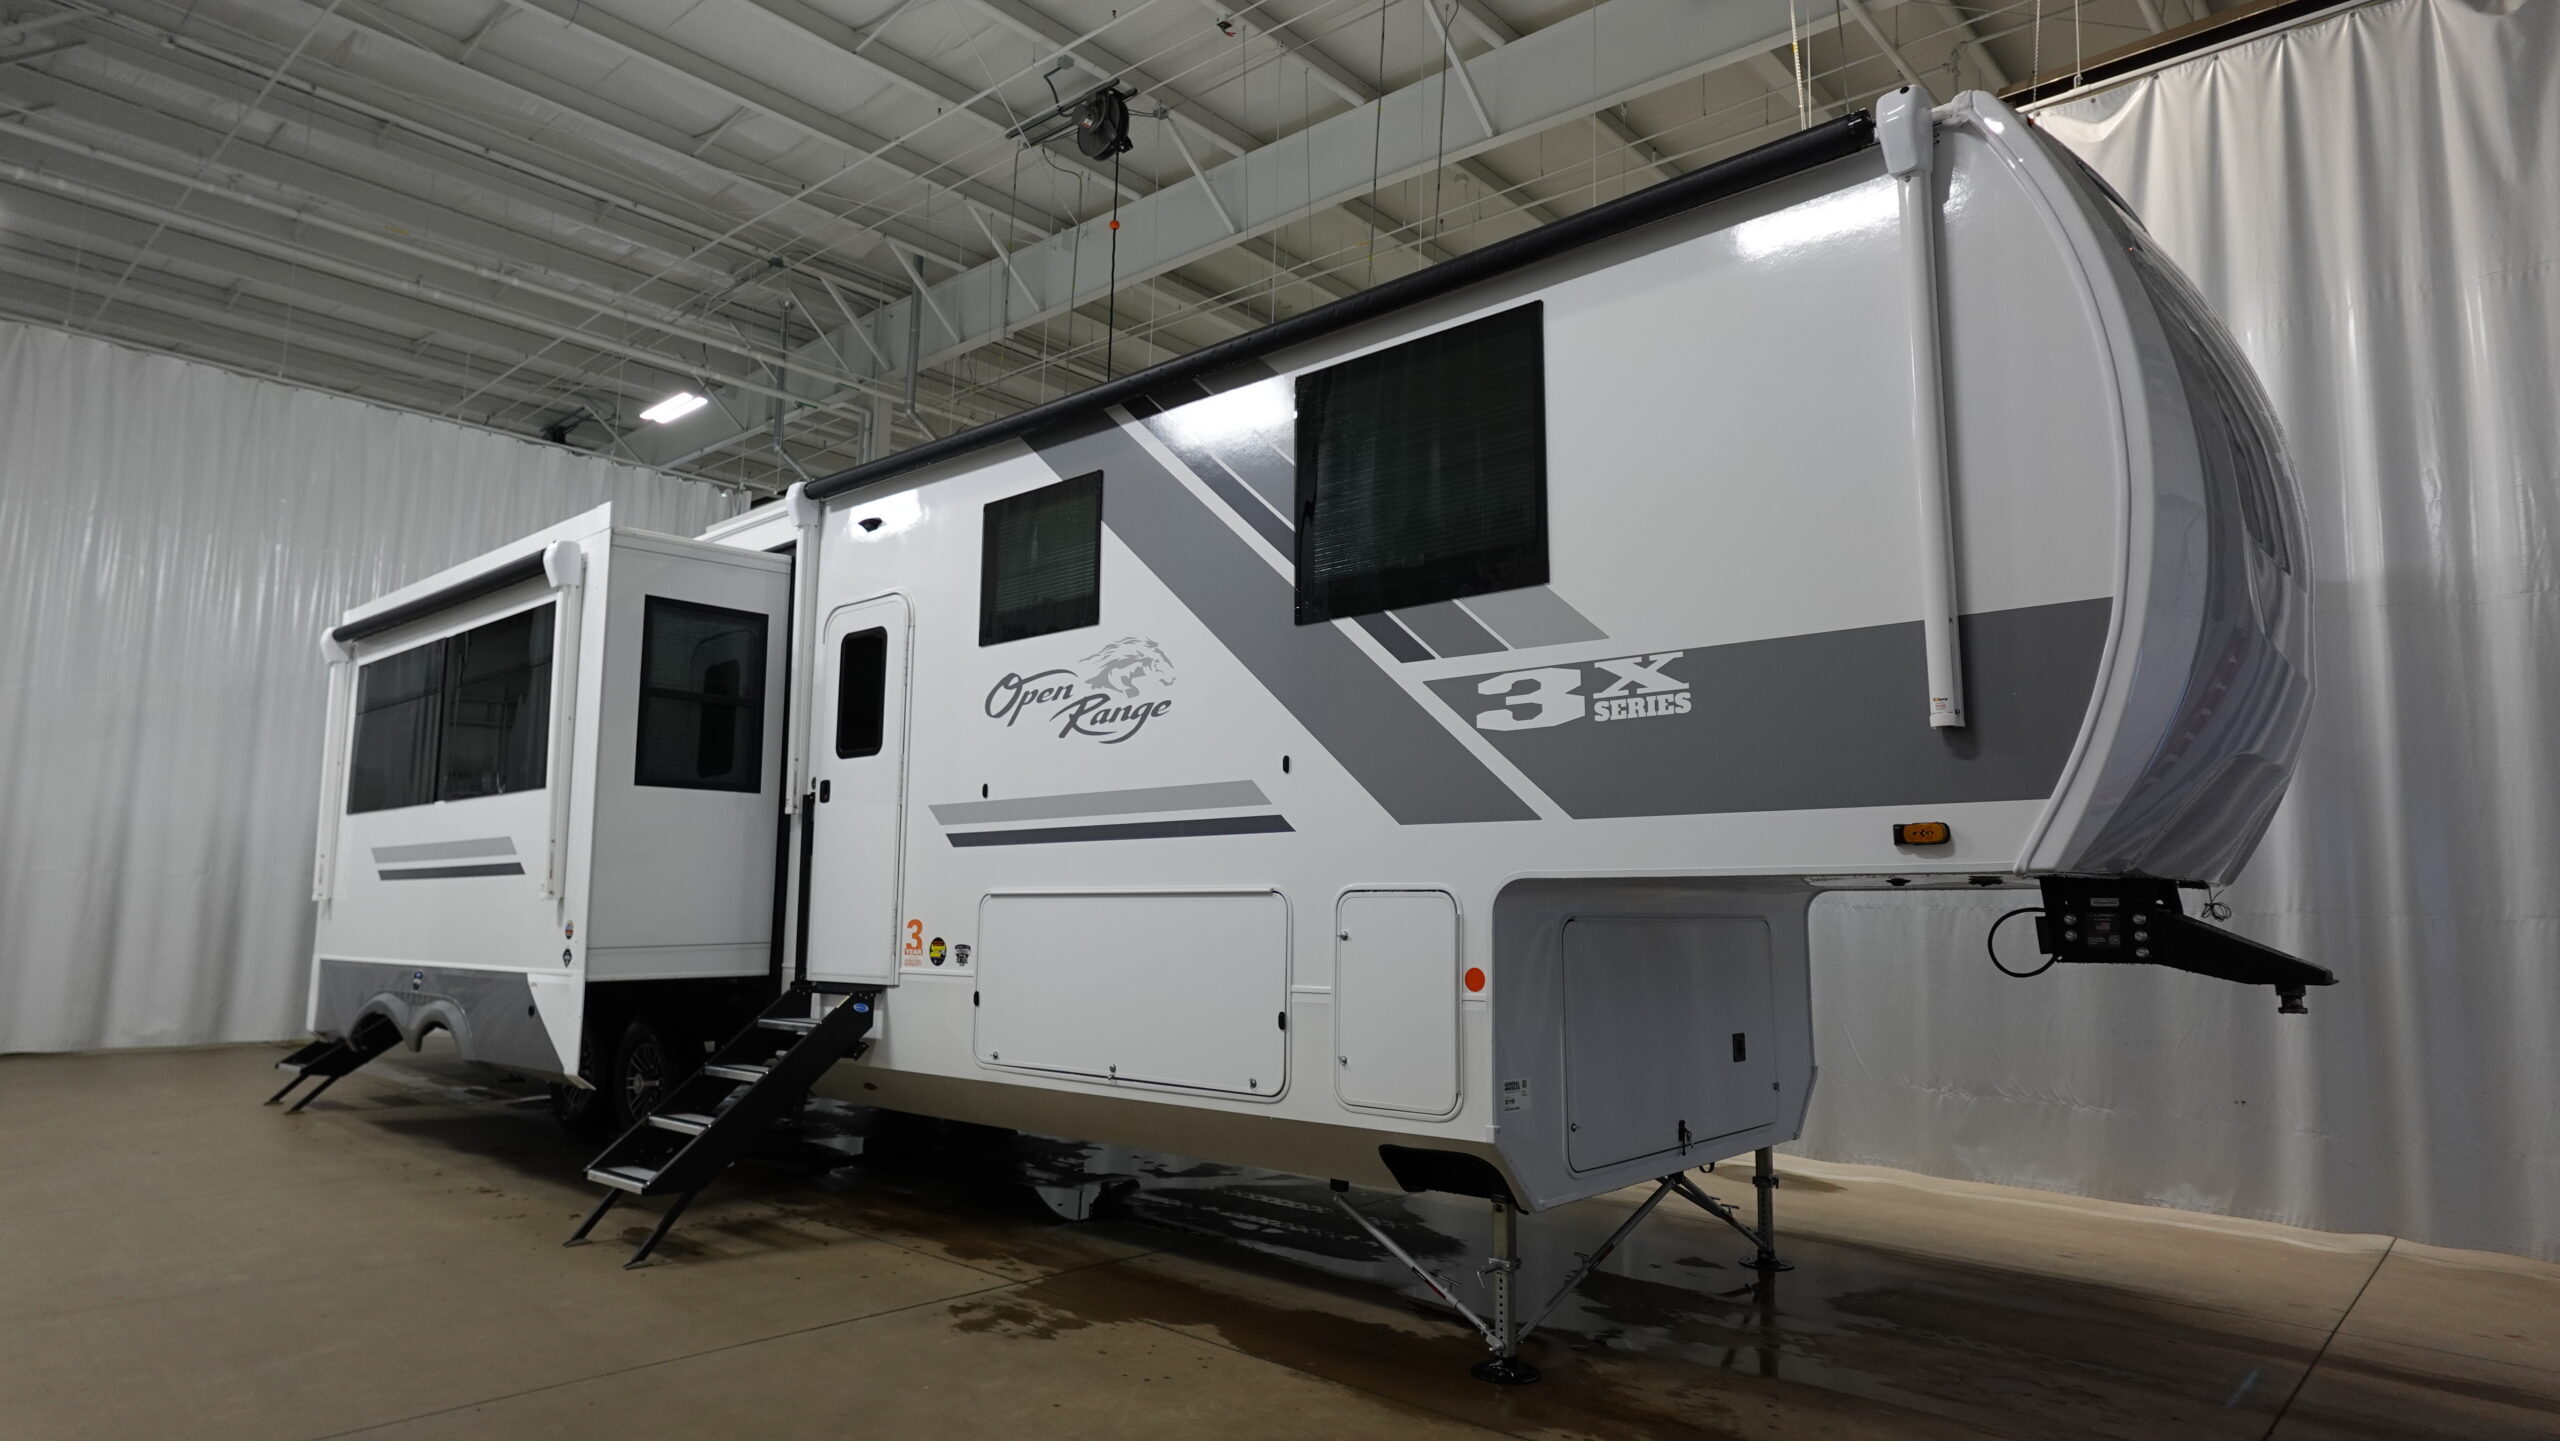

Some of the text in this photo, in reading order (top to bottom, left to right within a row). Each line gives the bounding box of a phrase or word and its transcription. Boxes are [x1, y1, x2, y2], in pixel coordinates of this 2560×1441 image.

[985, 669, 1078, 727] Open
[1049, 693, 1173, 744] Range
[1594, 692, 1691, 722] SERIES
[905, 919, 923, 950] 3
